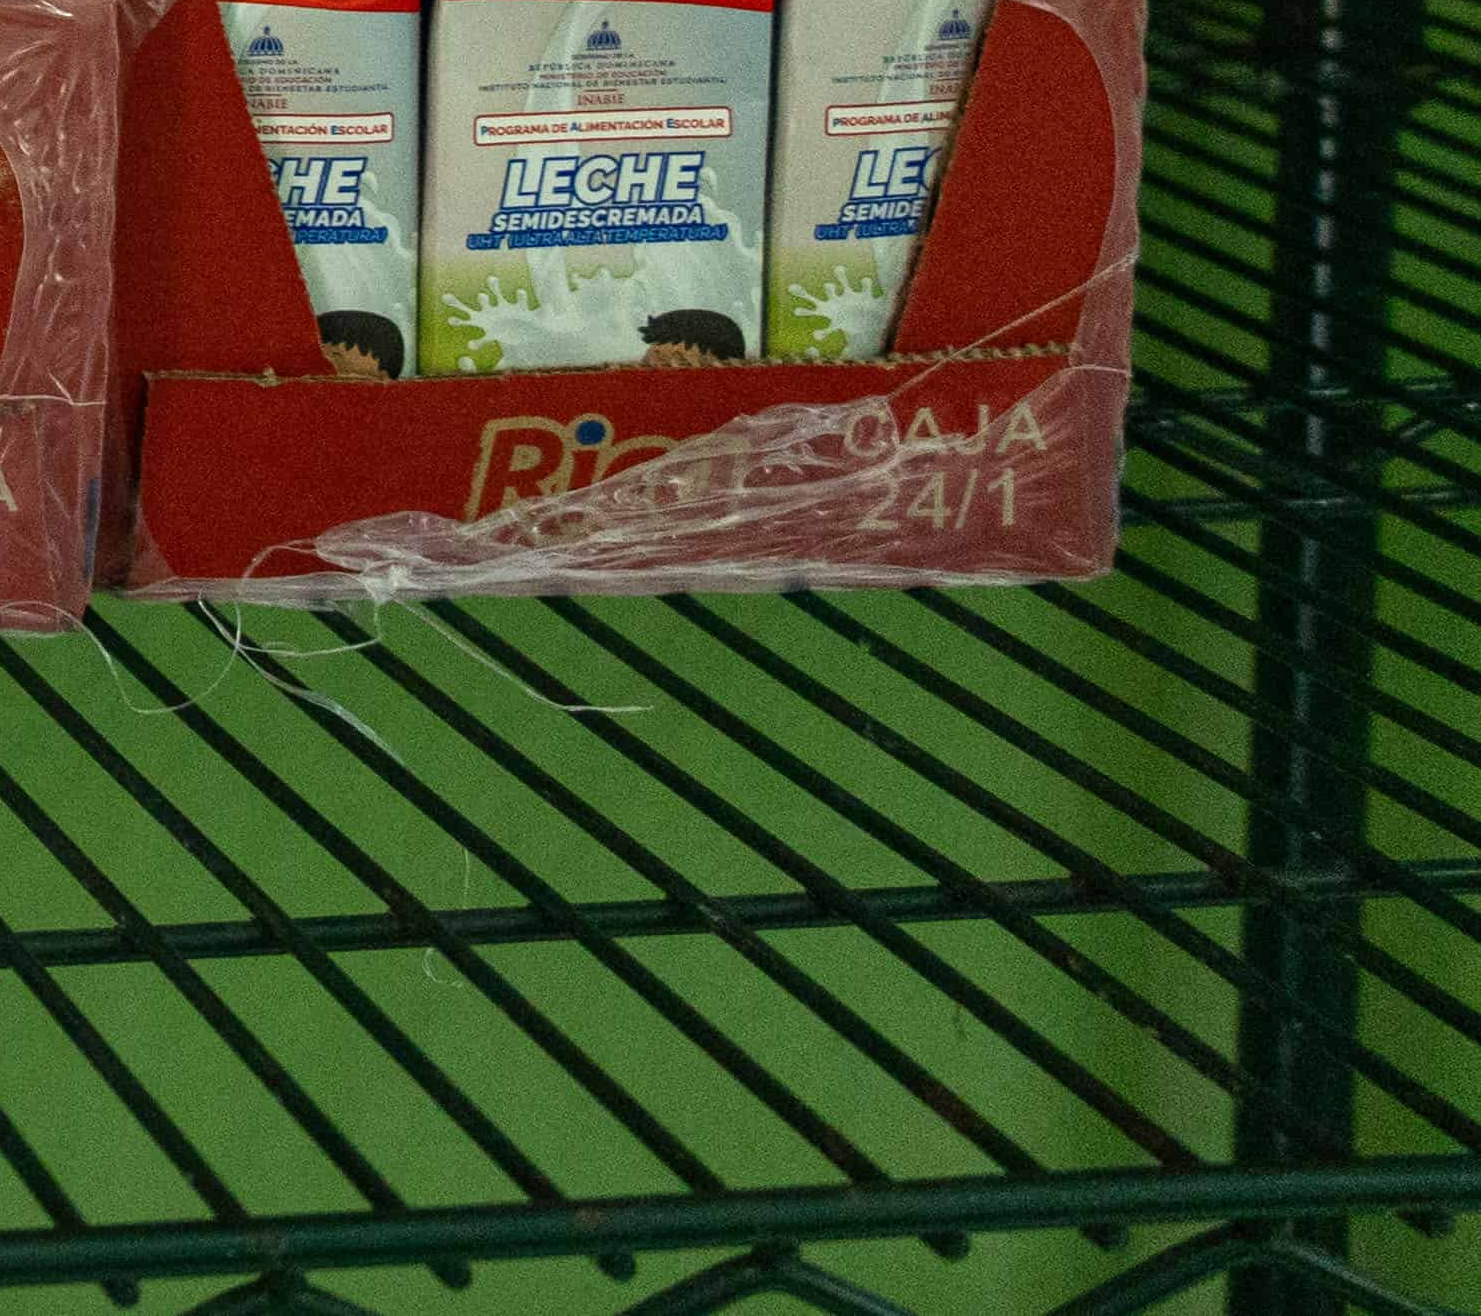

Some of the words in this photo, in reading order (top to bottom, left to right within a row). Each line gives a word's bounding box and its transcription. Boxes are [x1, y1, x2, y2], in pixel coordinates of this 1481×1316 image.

[501, 154, 705, 208] LECHE
[489, 207, 704, 230] SEMIDESCREMADA
[843, 406, 1046, 455] CAJA
[864, 468, 1016, 531] 24/1
